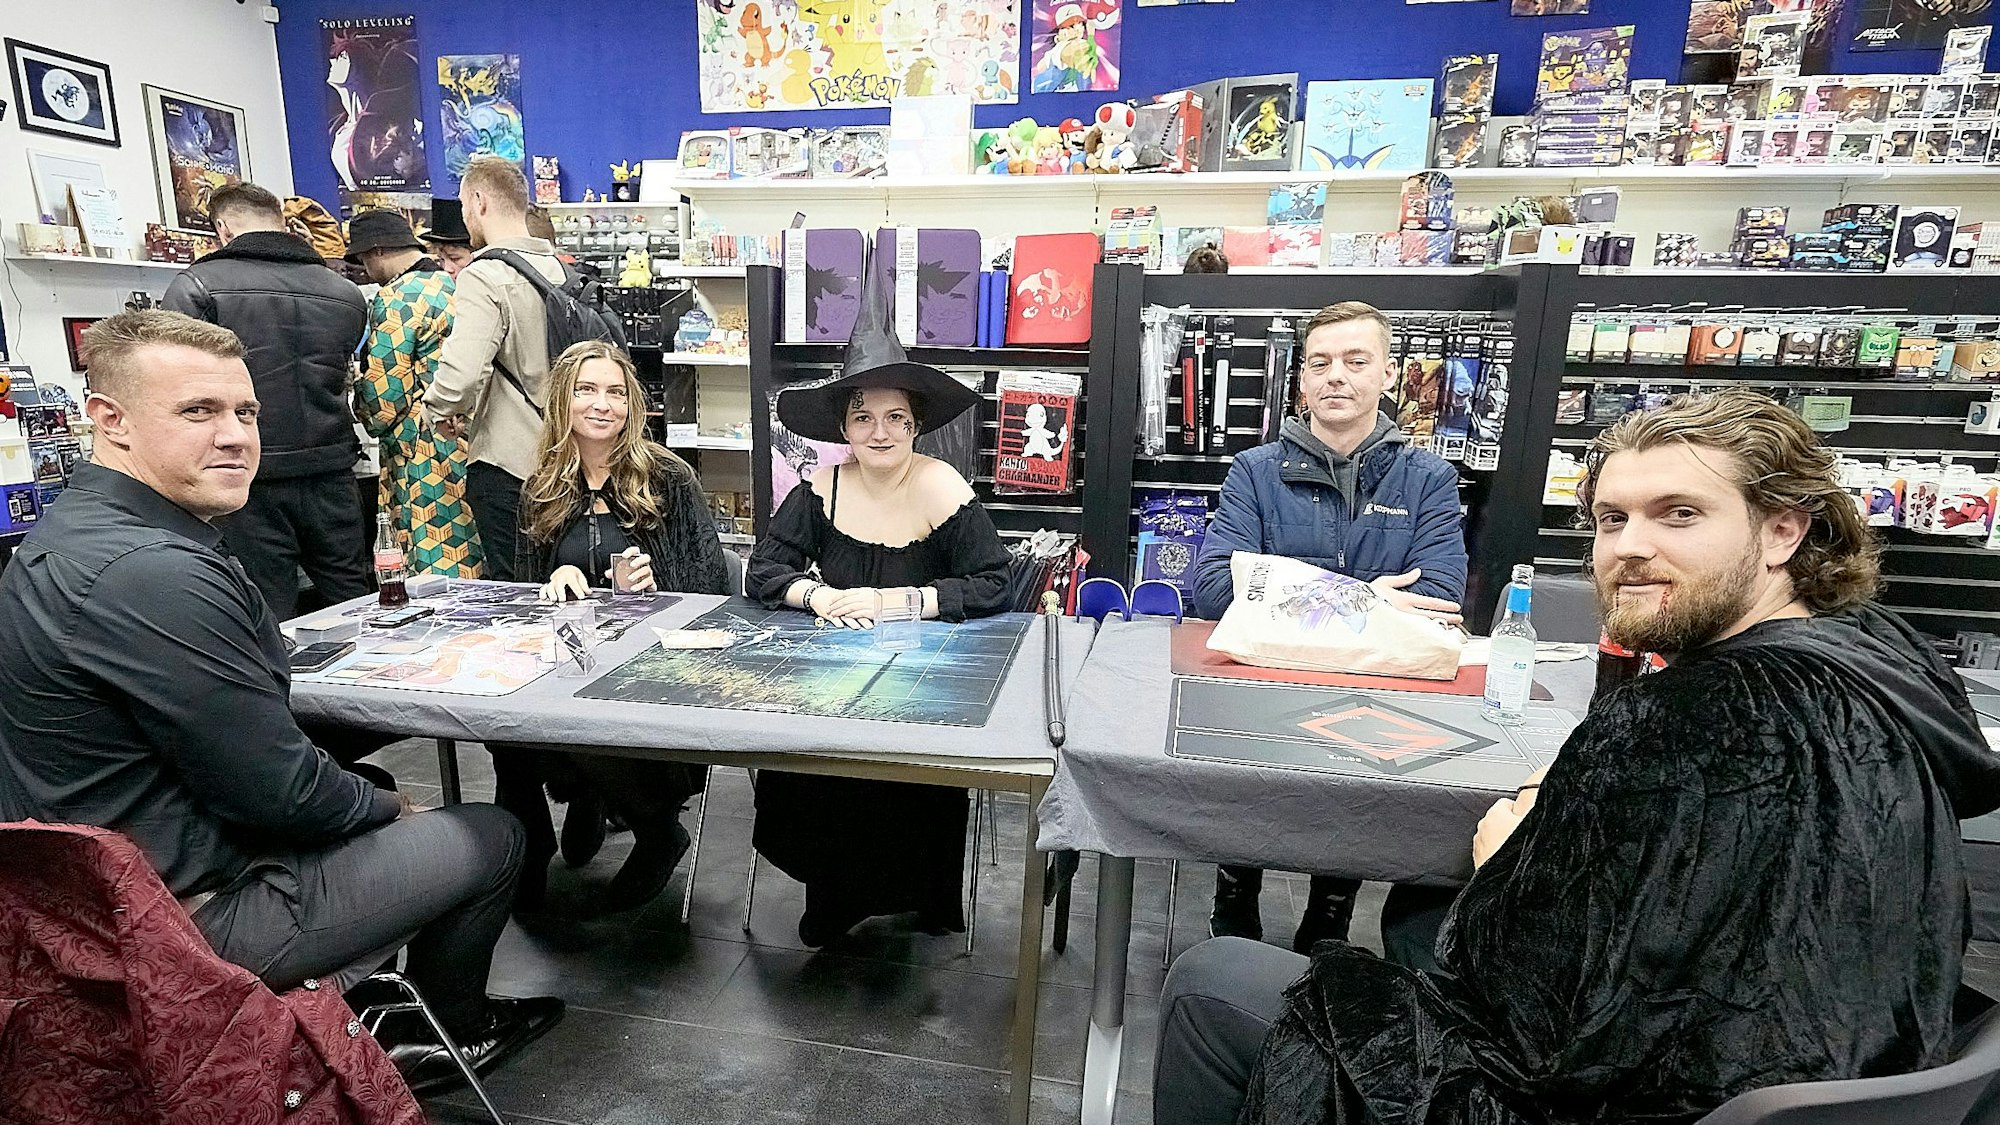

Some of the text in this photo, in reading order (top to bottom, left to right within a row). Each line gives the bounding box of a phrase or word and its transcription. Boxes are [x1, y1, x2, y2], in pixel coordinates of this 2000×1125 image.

[322, 19, 351, 29] SOLO
[1000, 457, 1028, 471] KANTO
[999, 469, 1060, 486] CHARMANDER
